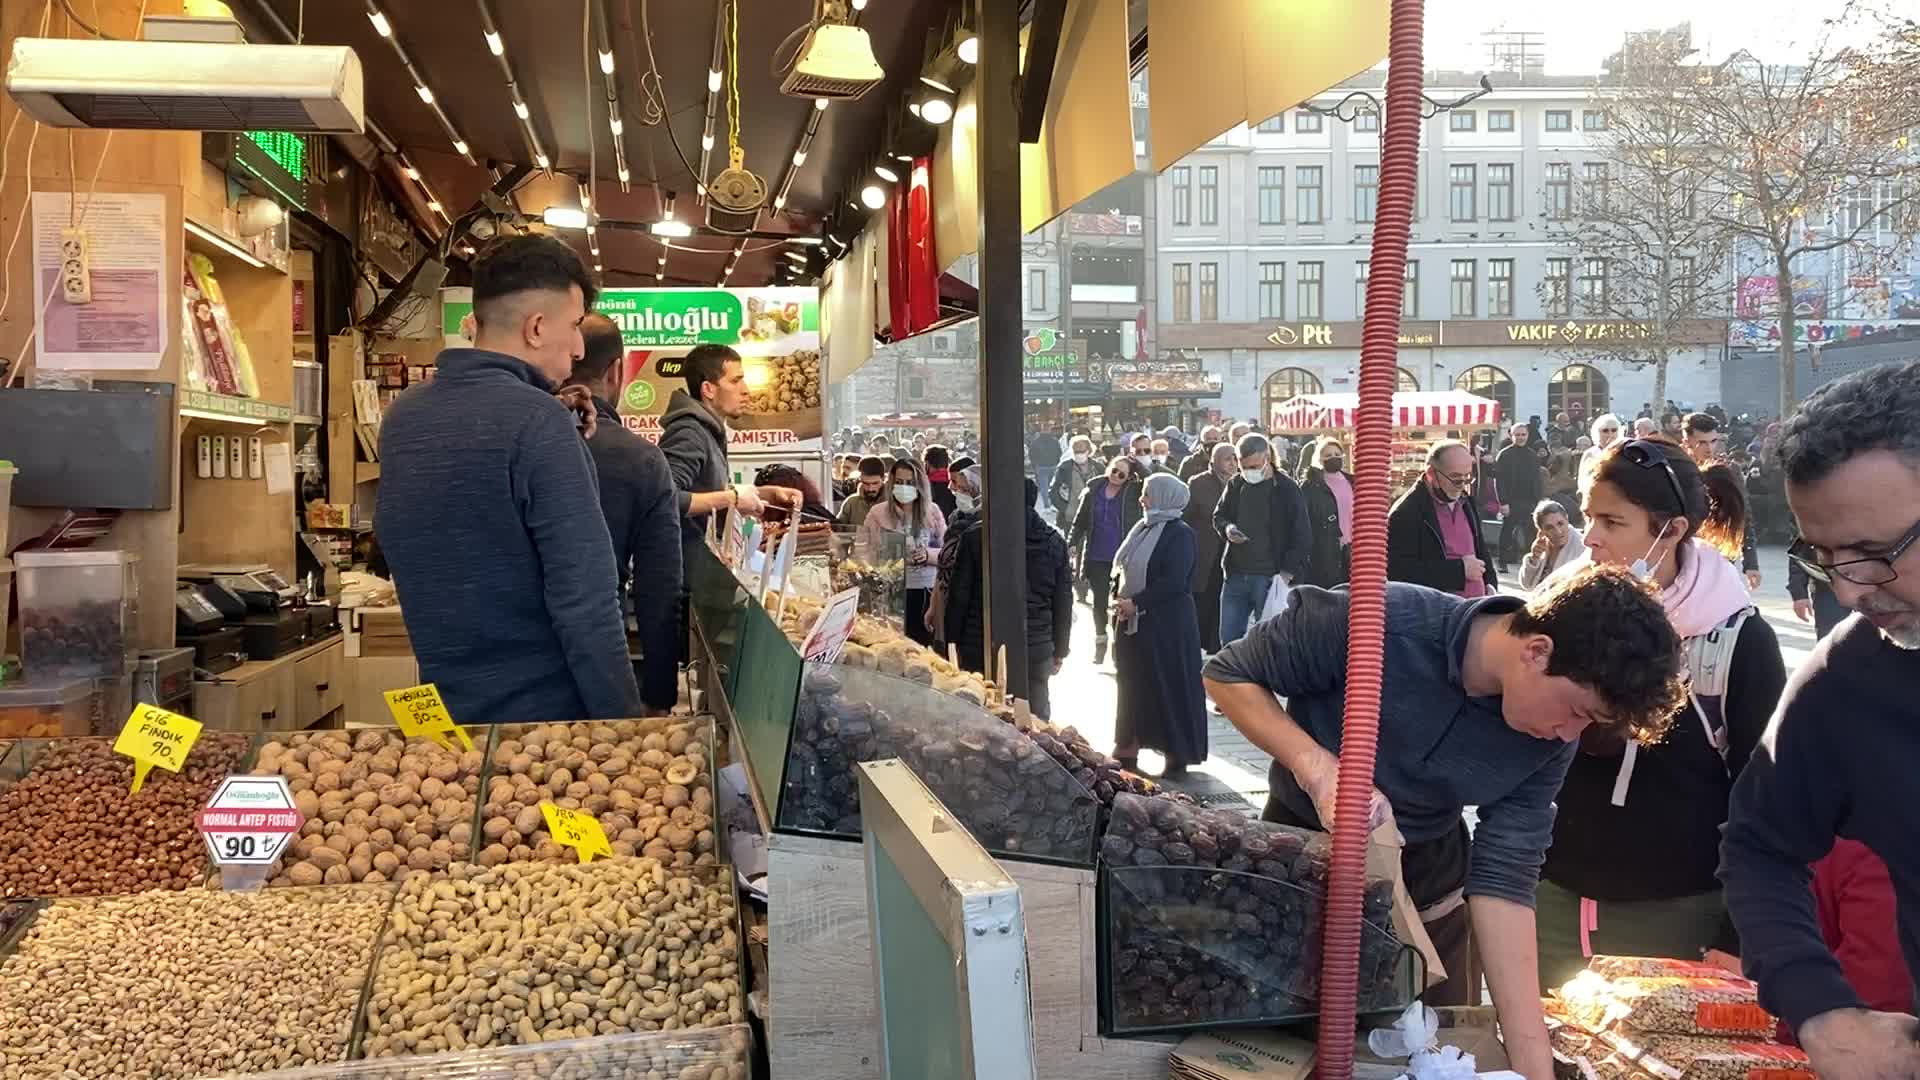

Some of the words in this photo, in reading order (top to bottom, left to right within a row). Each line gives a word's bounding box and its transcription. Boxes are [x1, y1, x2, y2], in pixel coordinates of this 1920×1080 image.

[1303, 324, 1332, 344] Ptt
[1507, 325, 1557, 340] VAKIF
[151, 741, 172, 757] 90
[202, 813, 238, 827] NORMAL
[238, 813, 267, 827] ANTEP
[225, 835, 256, 858] 90
